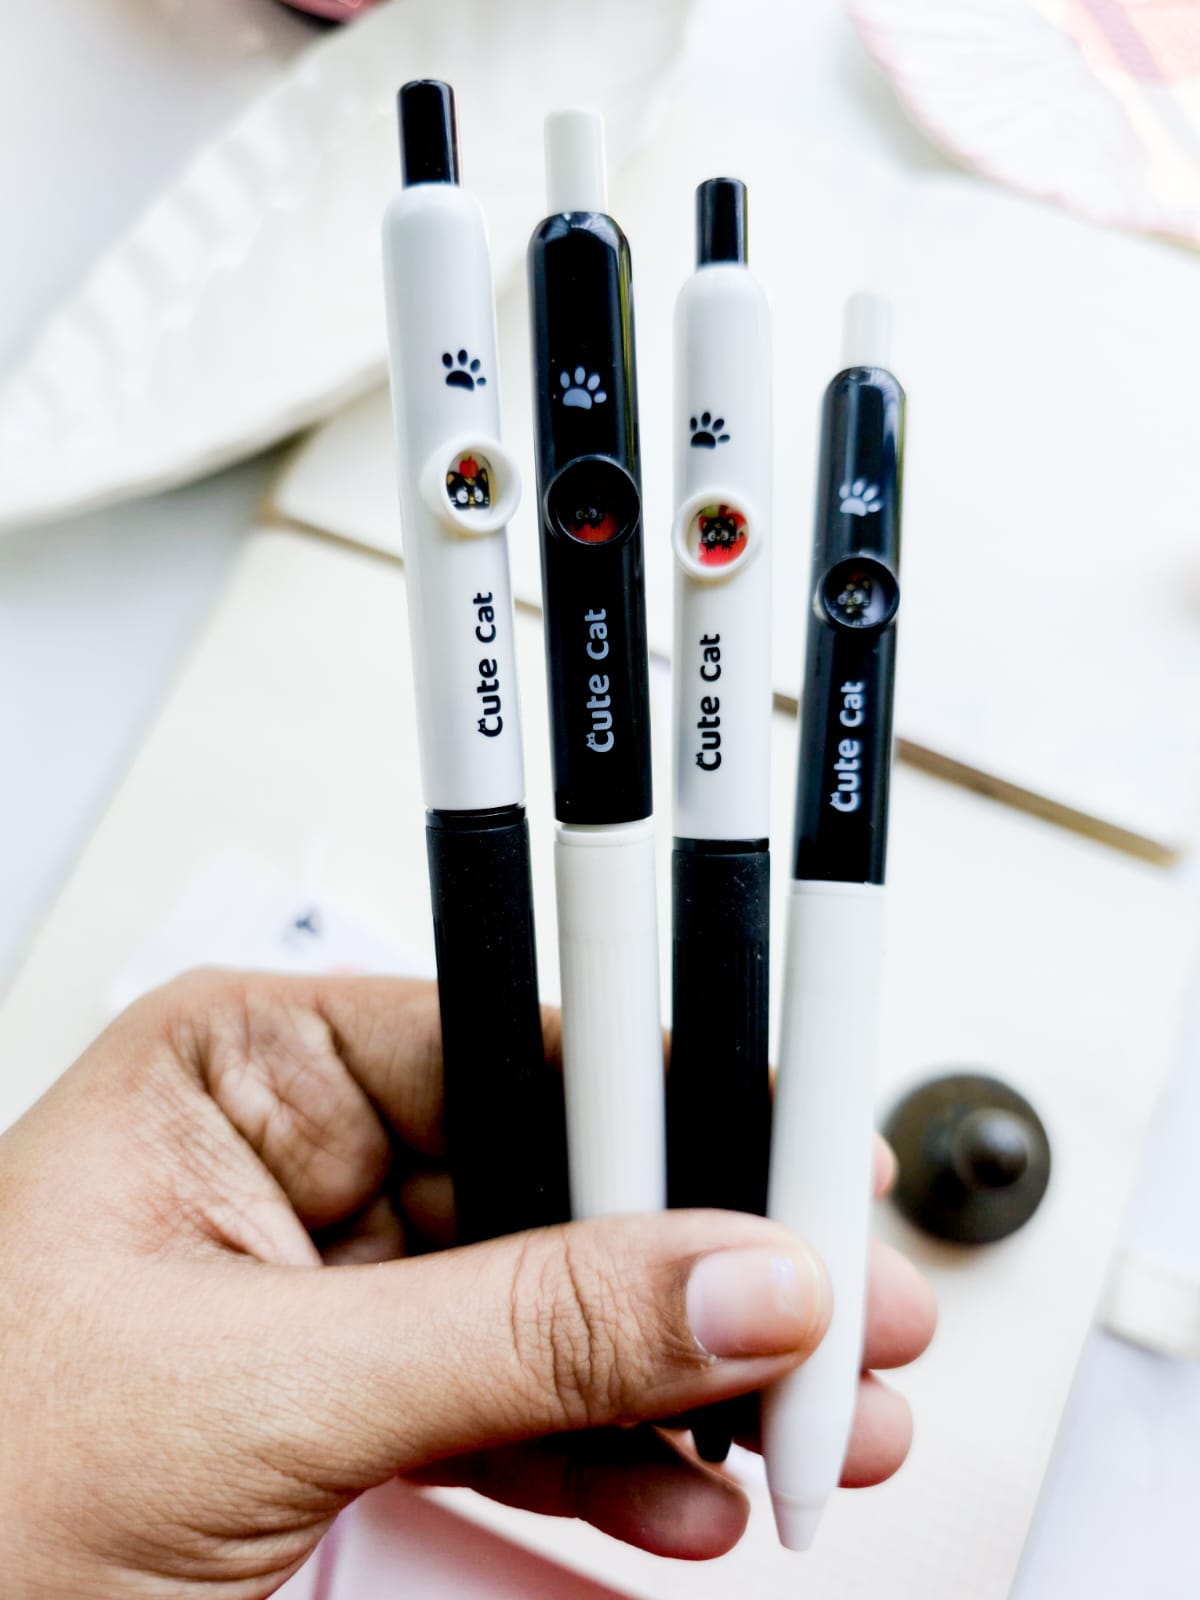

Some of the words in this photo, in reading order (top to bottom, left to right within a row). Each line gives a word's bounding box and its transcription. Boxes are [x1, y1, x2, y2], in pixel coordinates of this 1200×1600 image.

[477, 658, 503, 738] Cute
[586, 674, 615, 753] Cute
[696, 695, 722, 772] Cute
[830, 738, 861, 812] Cute
